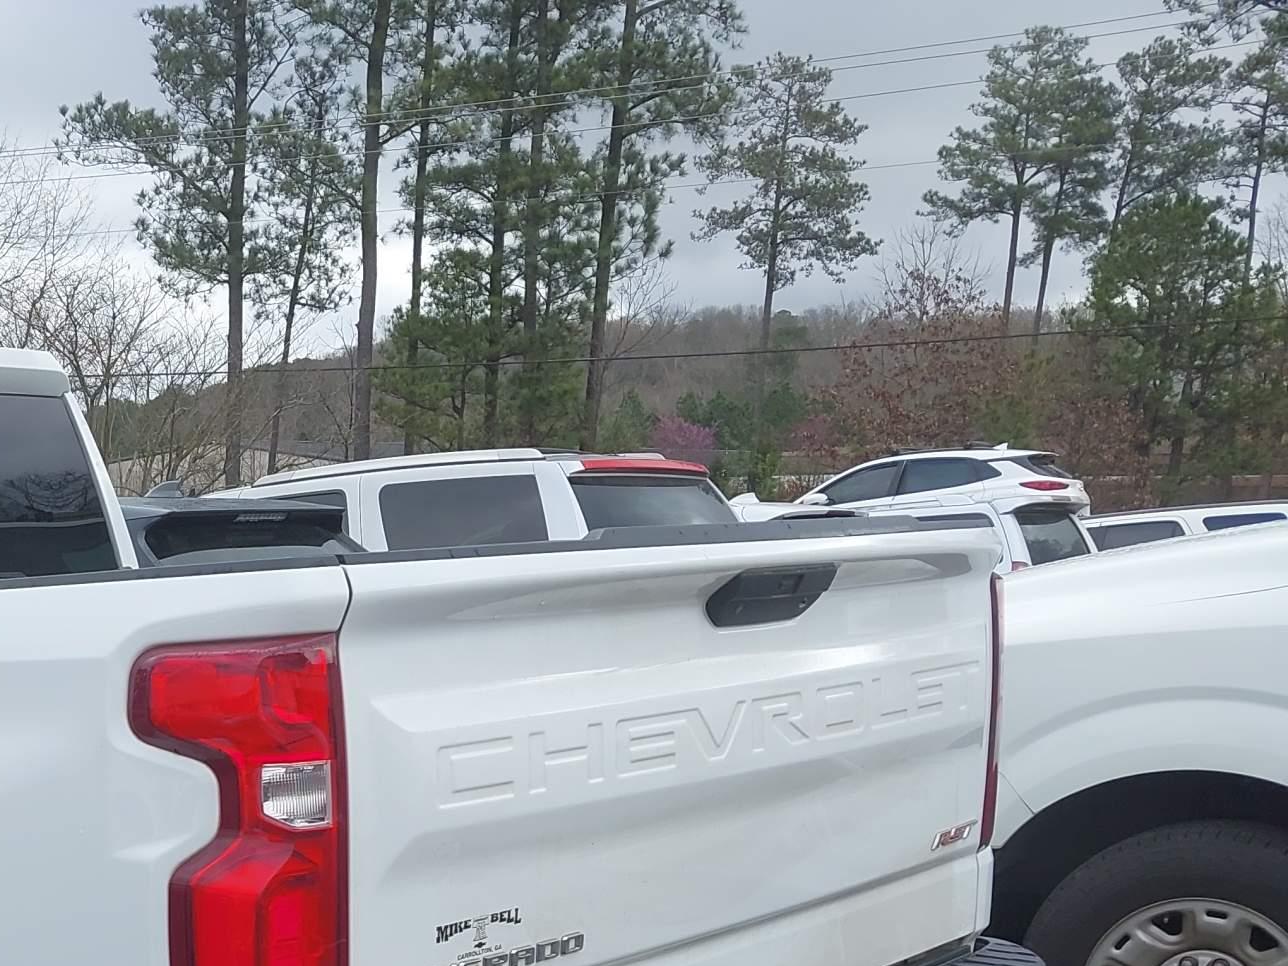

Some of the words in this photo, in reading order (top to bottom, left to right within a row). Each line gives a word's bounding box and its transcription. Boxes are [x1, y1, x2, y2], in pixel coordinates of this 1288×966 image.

[435, 659, 980, 809] CHEVROLET
[930, 819, 979, 852] RST
[435, 918, 473, 943] MIKE
[490, 907, 523, 925] BELL
